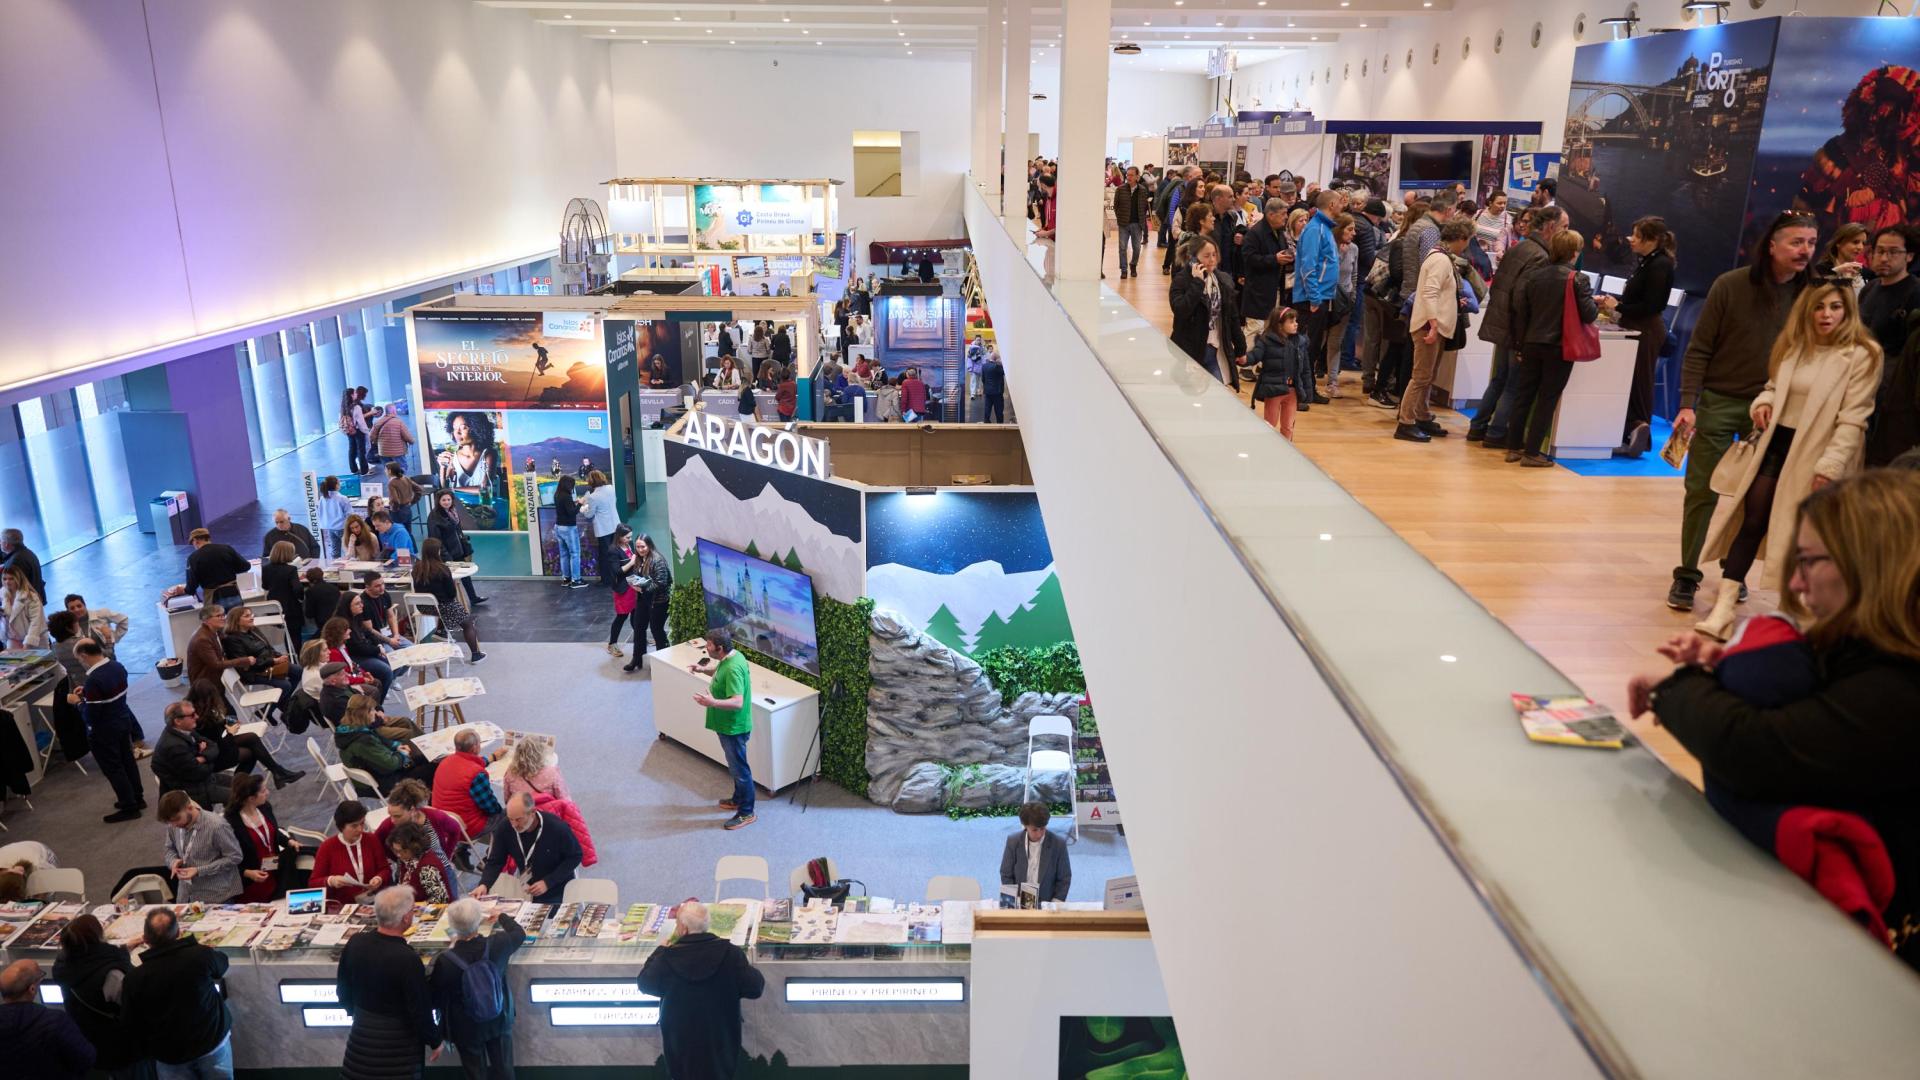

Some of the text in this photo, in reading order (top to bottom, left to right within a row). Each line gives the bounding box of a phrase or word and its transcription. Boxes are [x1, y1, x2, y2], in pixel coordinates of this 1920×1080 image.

[435, 350, 510, 369] SECRETO
[461, 340, 479, 351] EL
[447, 371, 507, 384] INTERIOR
[683, 411, 825, 480] ARAGÓN
[304, 474, 321, 542] FUERTEVENTURA
[526, 475, 537, 523] LANZAROTE
